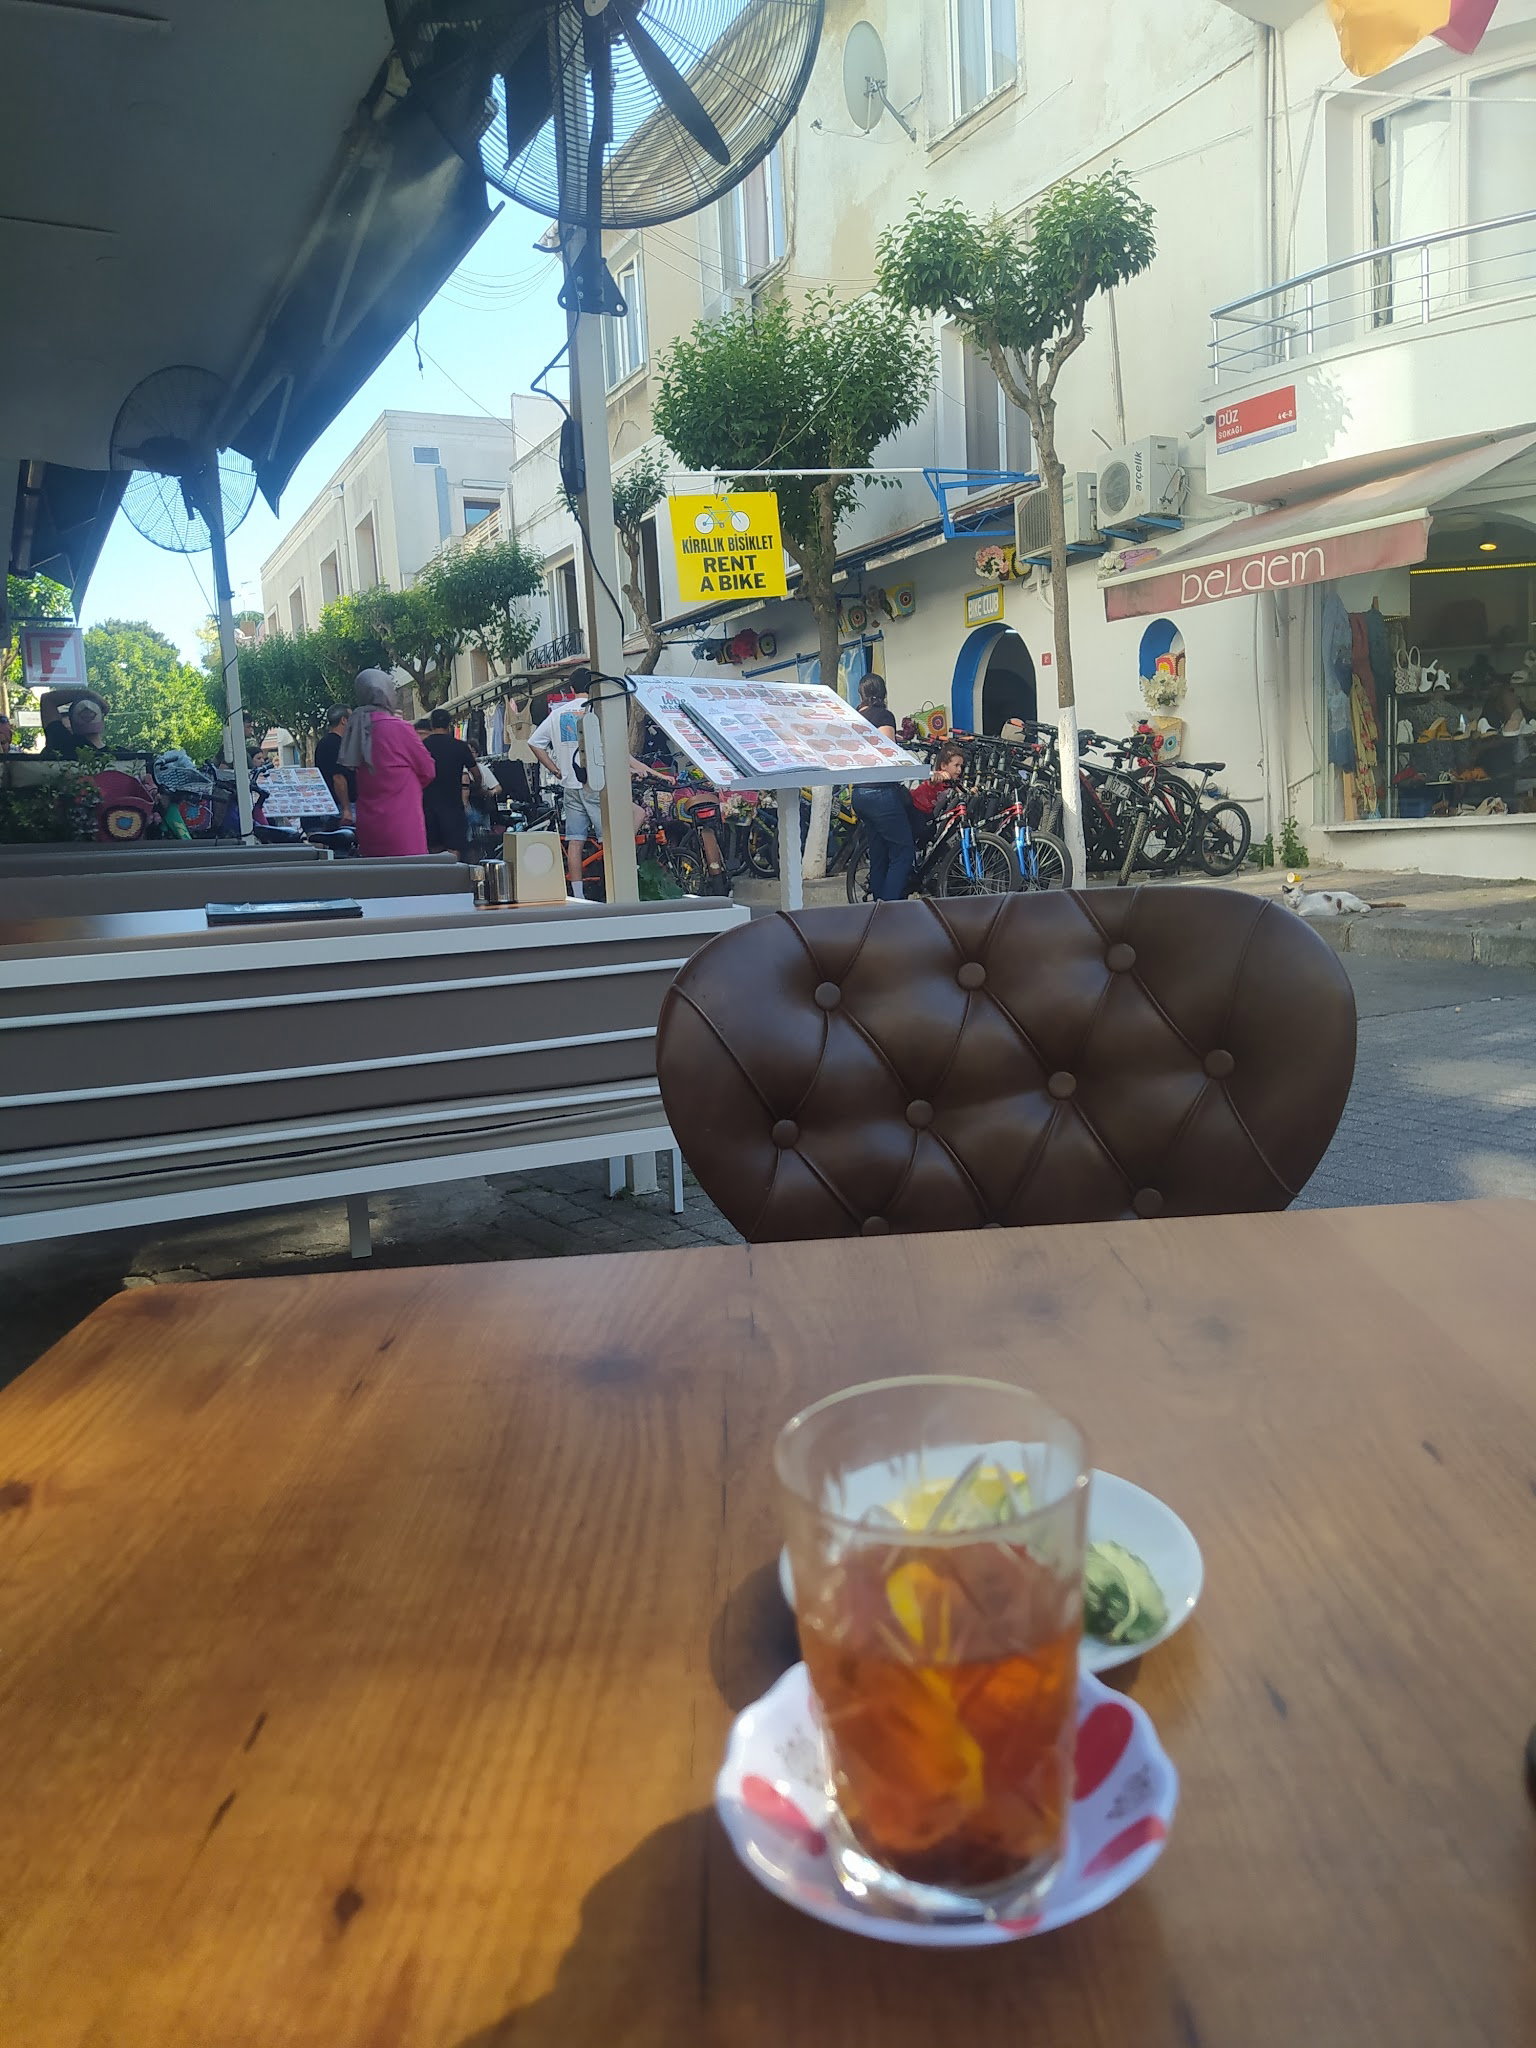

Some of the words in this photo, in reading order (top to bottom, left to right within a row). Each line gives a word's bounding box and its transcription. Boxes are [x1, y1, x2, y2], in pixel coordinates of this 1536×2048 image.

[1218, 409, 1239, 427] DÜZ
[1217, 425, 1243, 439] SOKAĞI
[1134, 451, 1143, 492] arçelik
[681, 536, 725, 554] KİRALIK
[727, 533, 773, 552] BİSİKLET
[703, 554, 757, 573] RENT
[700, 575, 715, 593] A
[718, 572, 767, 591] BIKE
[983, 593, 999, 615] CLUB
[40, 640, 68, 675] E
